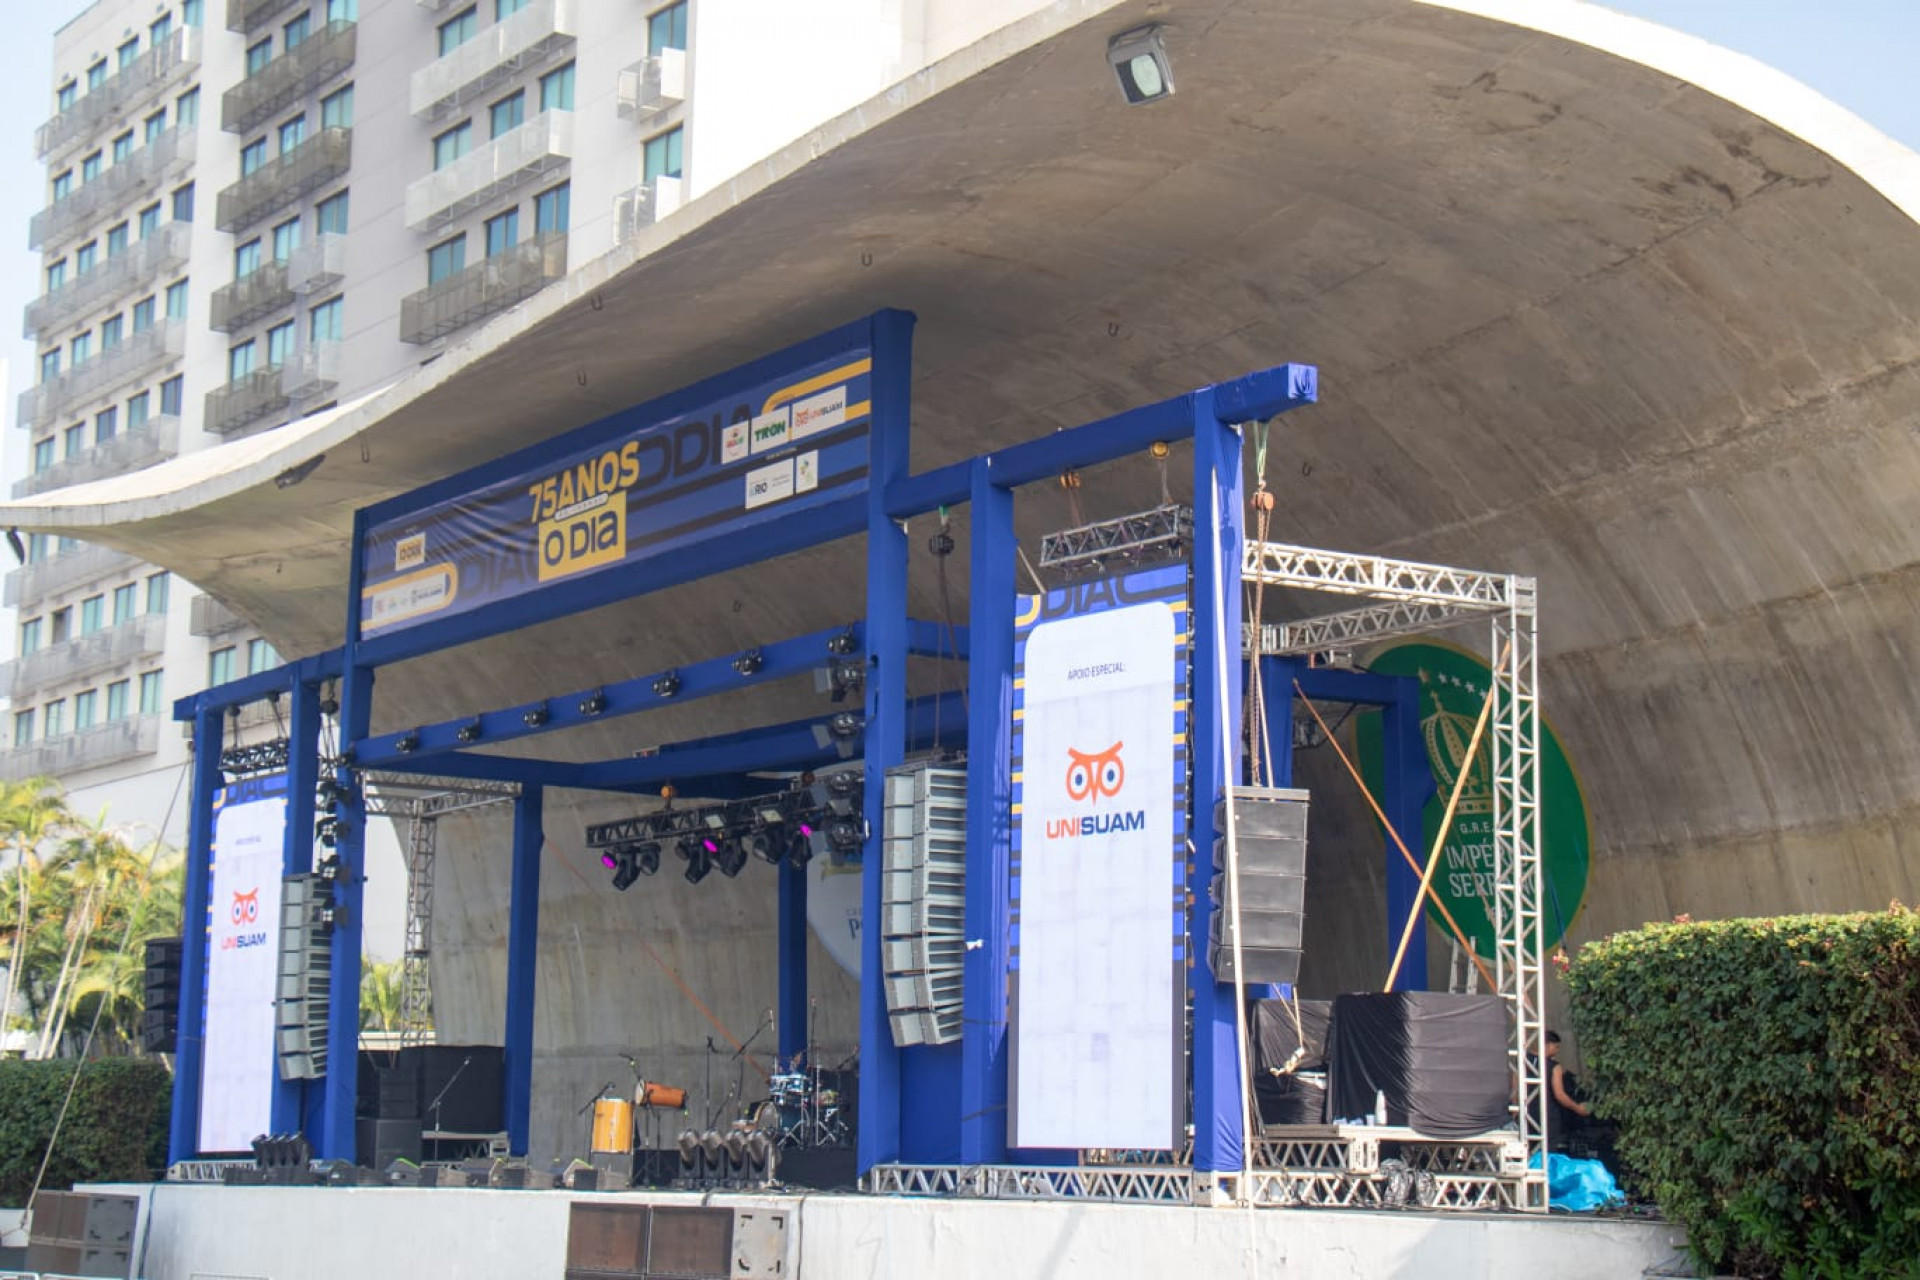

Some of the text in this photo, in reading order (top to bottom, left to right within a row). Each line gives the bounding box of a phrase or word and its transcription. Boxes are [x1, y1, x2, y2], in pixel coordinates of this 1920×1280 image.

[755, 420, 786, 442] TRON
[544, 530, 565, 567] O
[1067, 667, 1090, 680] APOIO
[1046, 810, 1145, 839] UNISUAM
